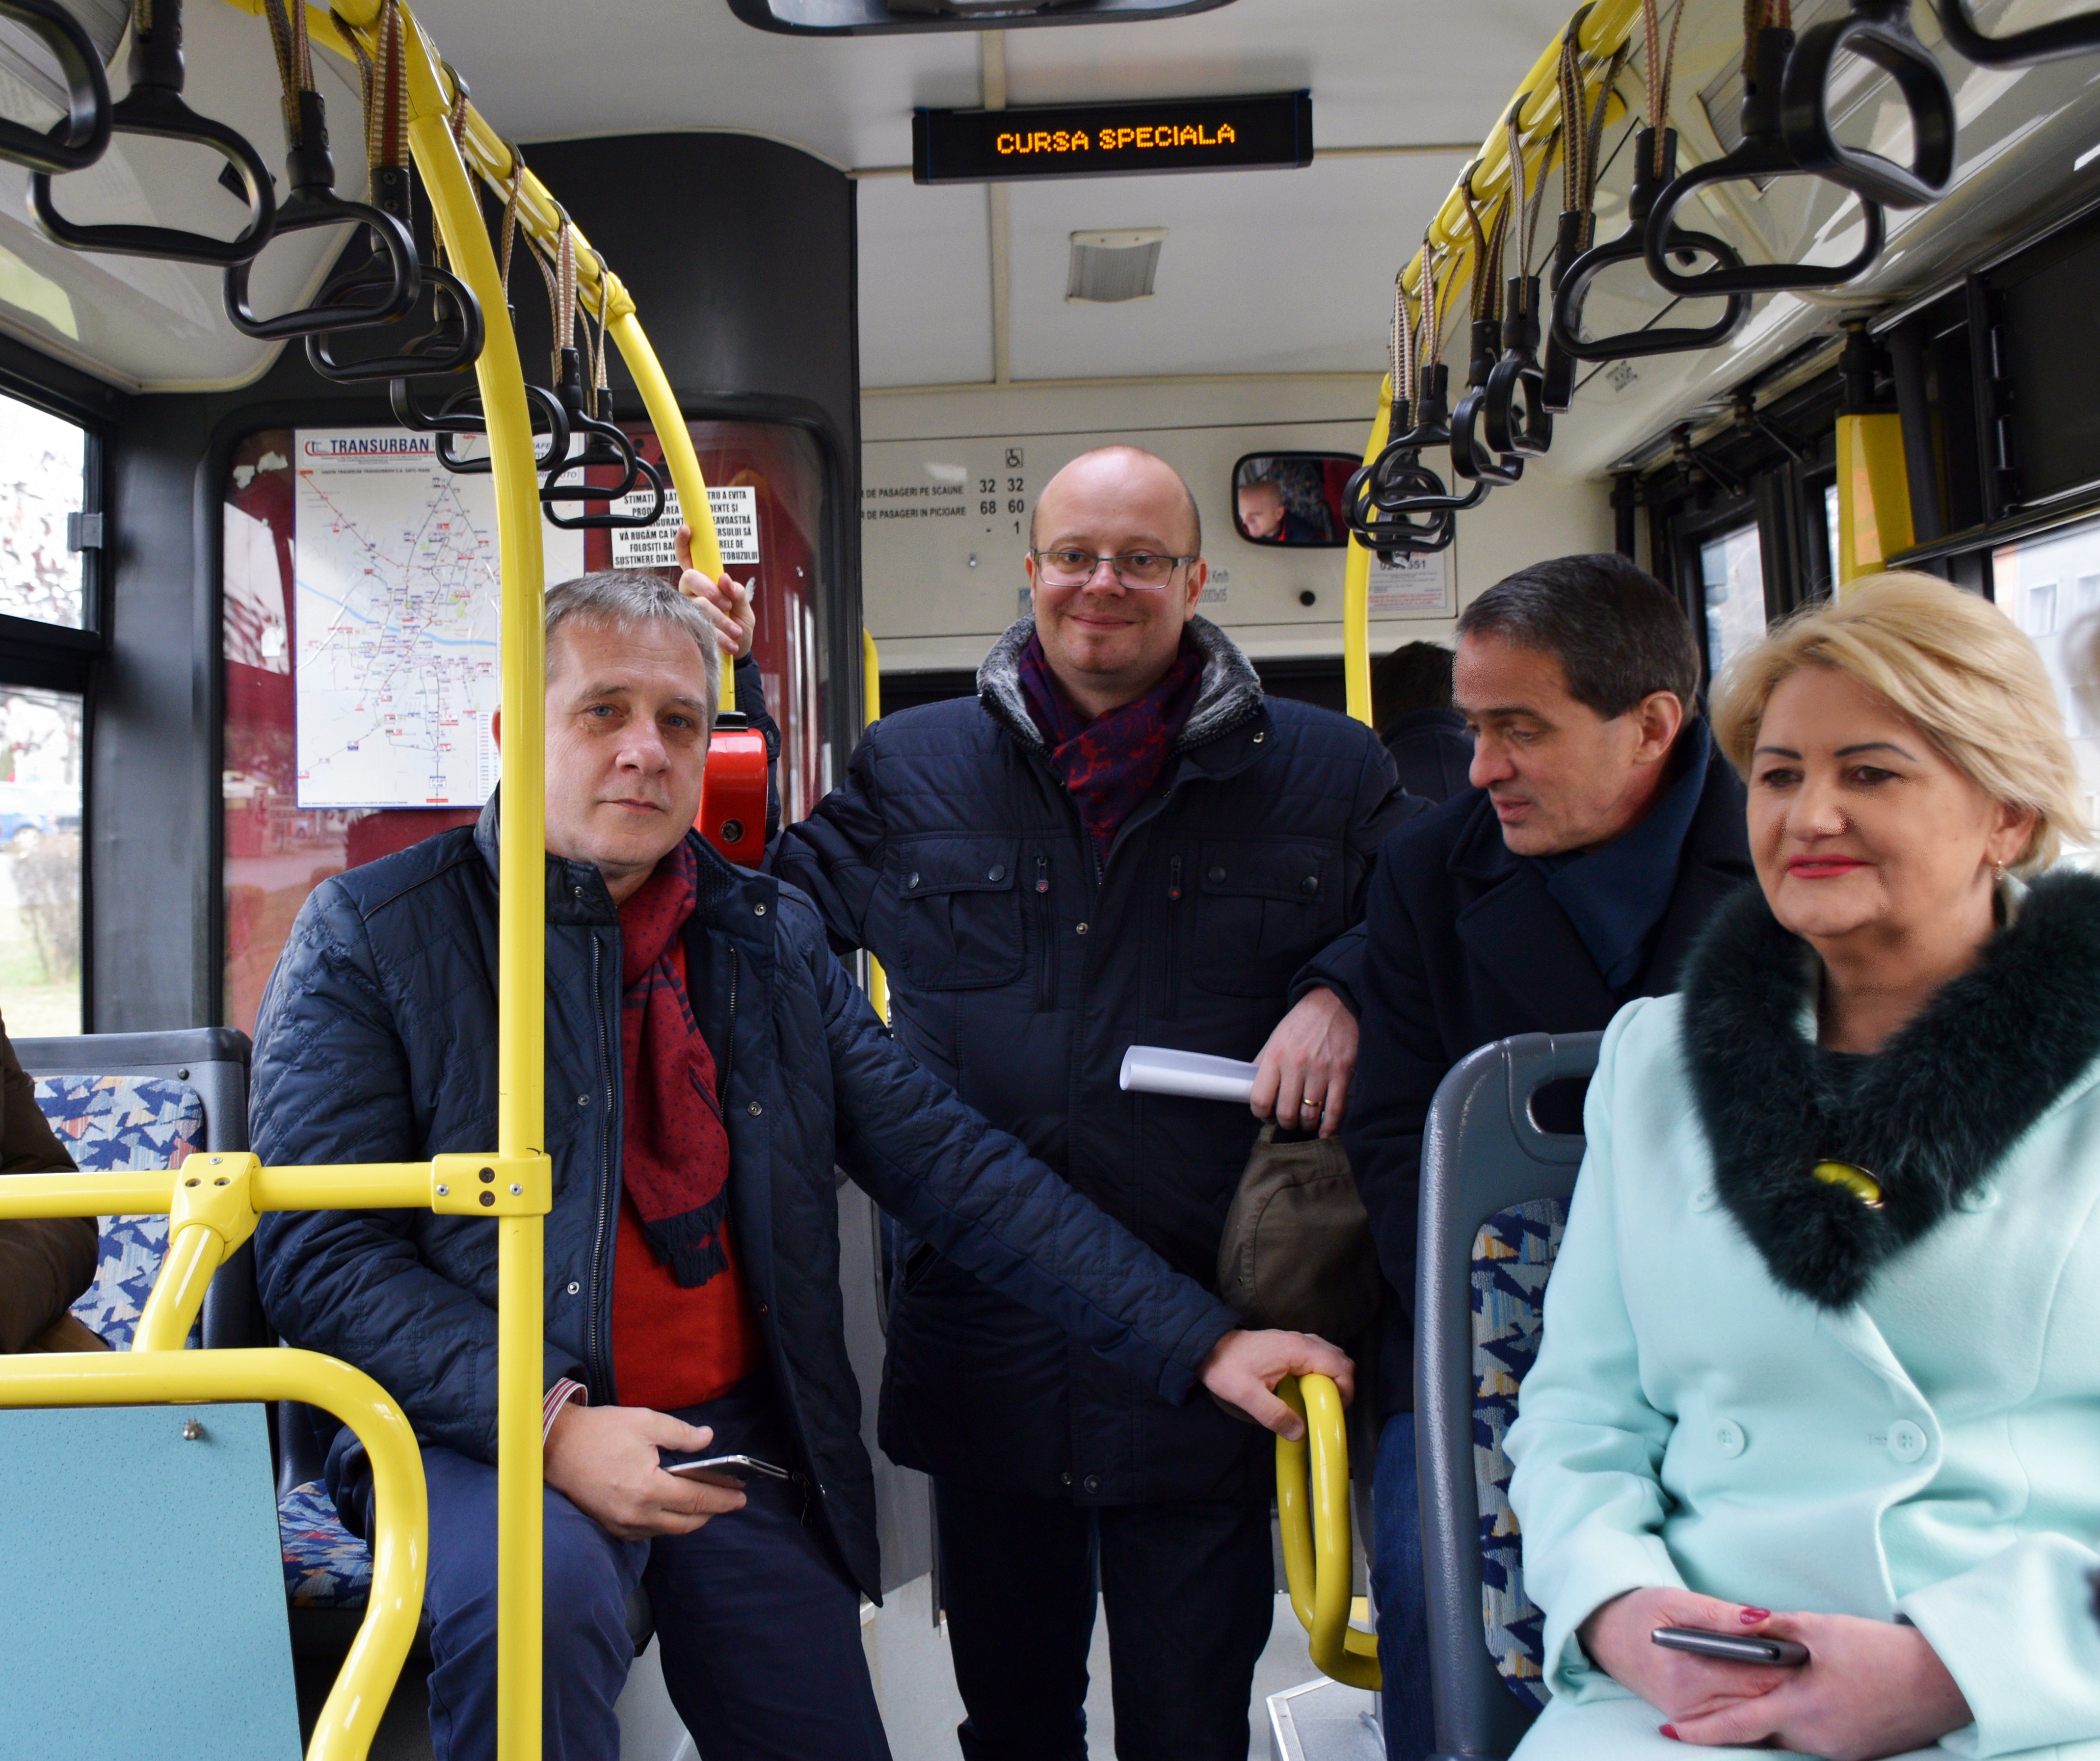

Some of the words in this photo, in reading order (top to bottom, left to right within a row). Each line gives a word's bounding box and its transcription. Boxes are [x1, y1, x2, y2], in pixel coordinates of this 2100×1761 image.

[997, 130, 1089, 154] CURSA
[1099, 124, 1235, 150] SPECIALA
[330, 438, 429, 452] TRANSURBAN
[722, 491, 726, 499] A
[729, 491, 746, 499] EVITA
[866, 489, 876, 498] DE
[879, 487, 917, 498] PASAGERI
[920, 487, 929, 496] PE
[932, 485, 963, 495] SCAUNE
[980, 479, 995, 493] 32
[1008, 478, 1023, 492] 32
[867, 510, 877, 520] DE
[879, 509, 918, 519] PASAGERI
[920, 508, 927, 517] IN
[930, 506, 966, 517] PICIOARE
[981, 500, 996, 514] 68
[1009, 499, 1024, 513] 60
[1014, 521, 1019, 534] 1
[736, 539, 744, 548] DE
